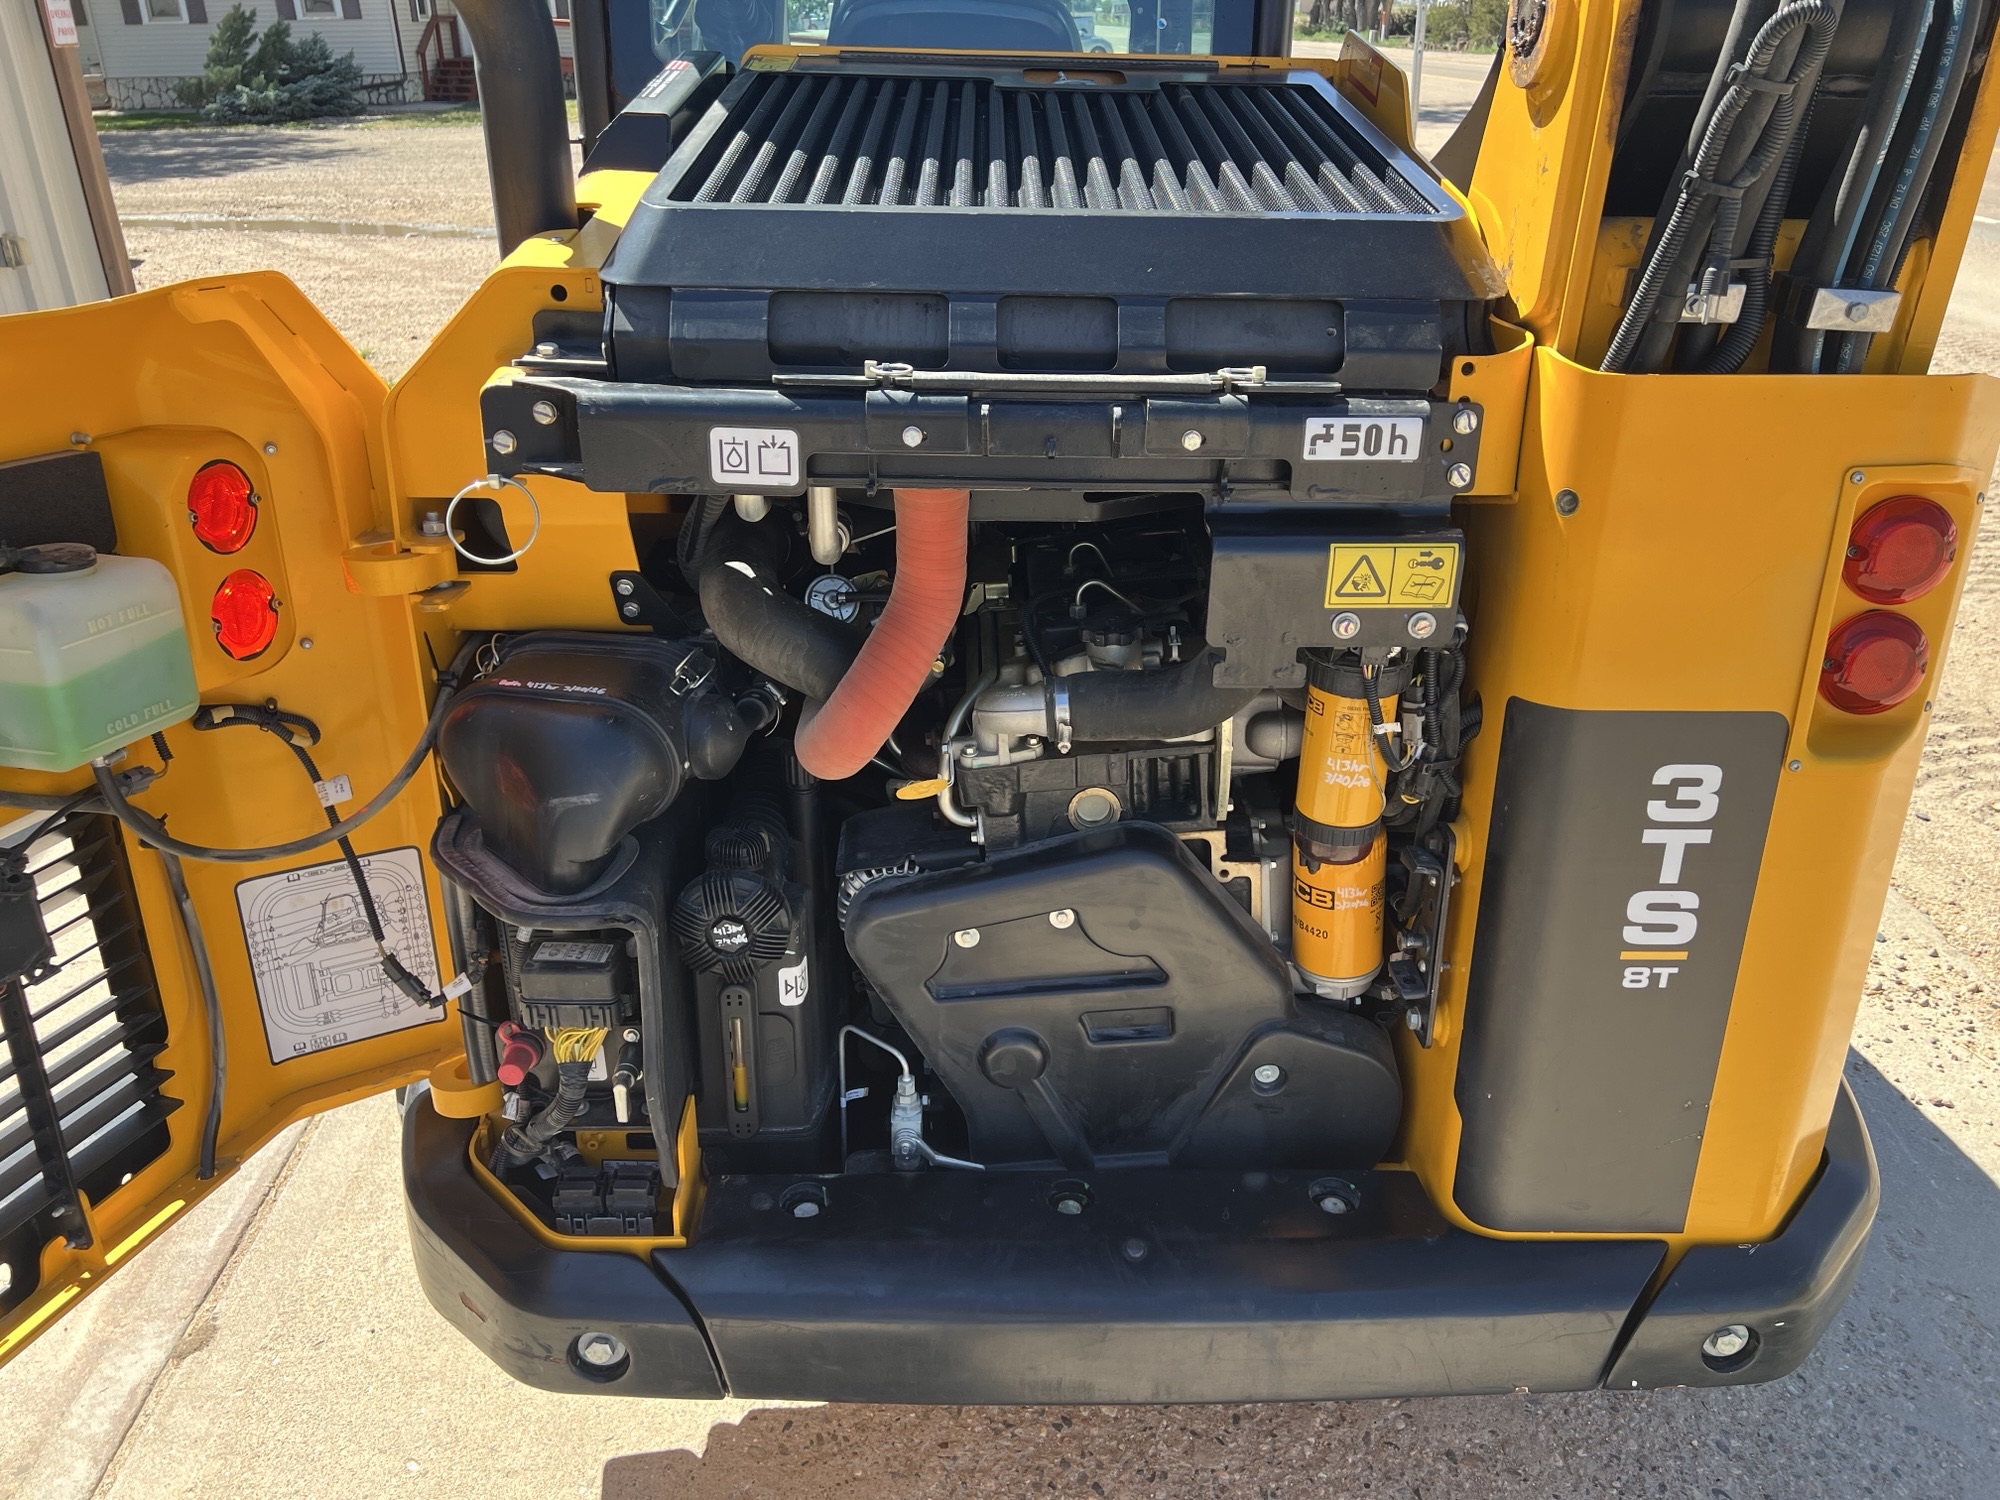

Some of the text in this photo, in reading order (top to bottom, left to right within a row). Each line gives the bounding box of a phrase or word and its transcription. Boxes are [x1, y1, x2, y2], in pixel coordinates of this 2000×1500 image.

[1945, 25, 1959, 45] MPa
[1940, 48, 1953, 67] 36.0
[1933, 76, 1945, 89] bar
[1928, 92, 1940, 108] 360
[1919, 116, 1931, 131] WP
[1896, 183, 1907, 194] 12
[1889, 196, 1902, 209] DN
[1879, 220, 1892, 238] 2SC
[1869, 240, 1884, 261] 11237
[1862, 264, 1875, 279] ISO
[87, 603, 151, 633] HOT FULL
[107, 699, 175, 734] COLD FULL
[1295, 878, 1335, 910] CB
[1622, 967, 1679, 988] 8T
